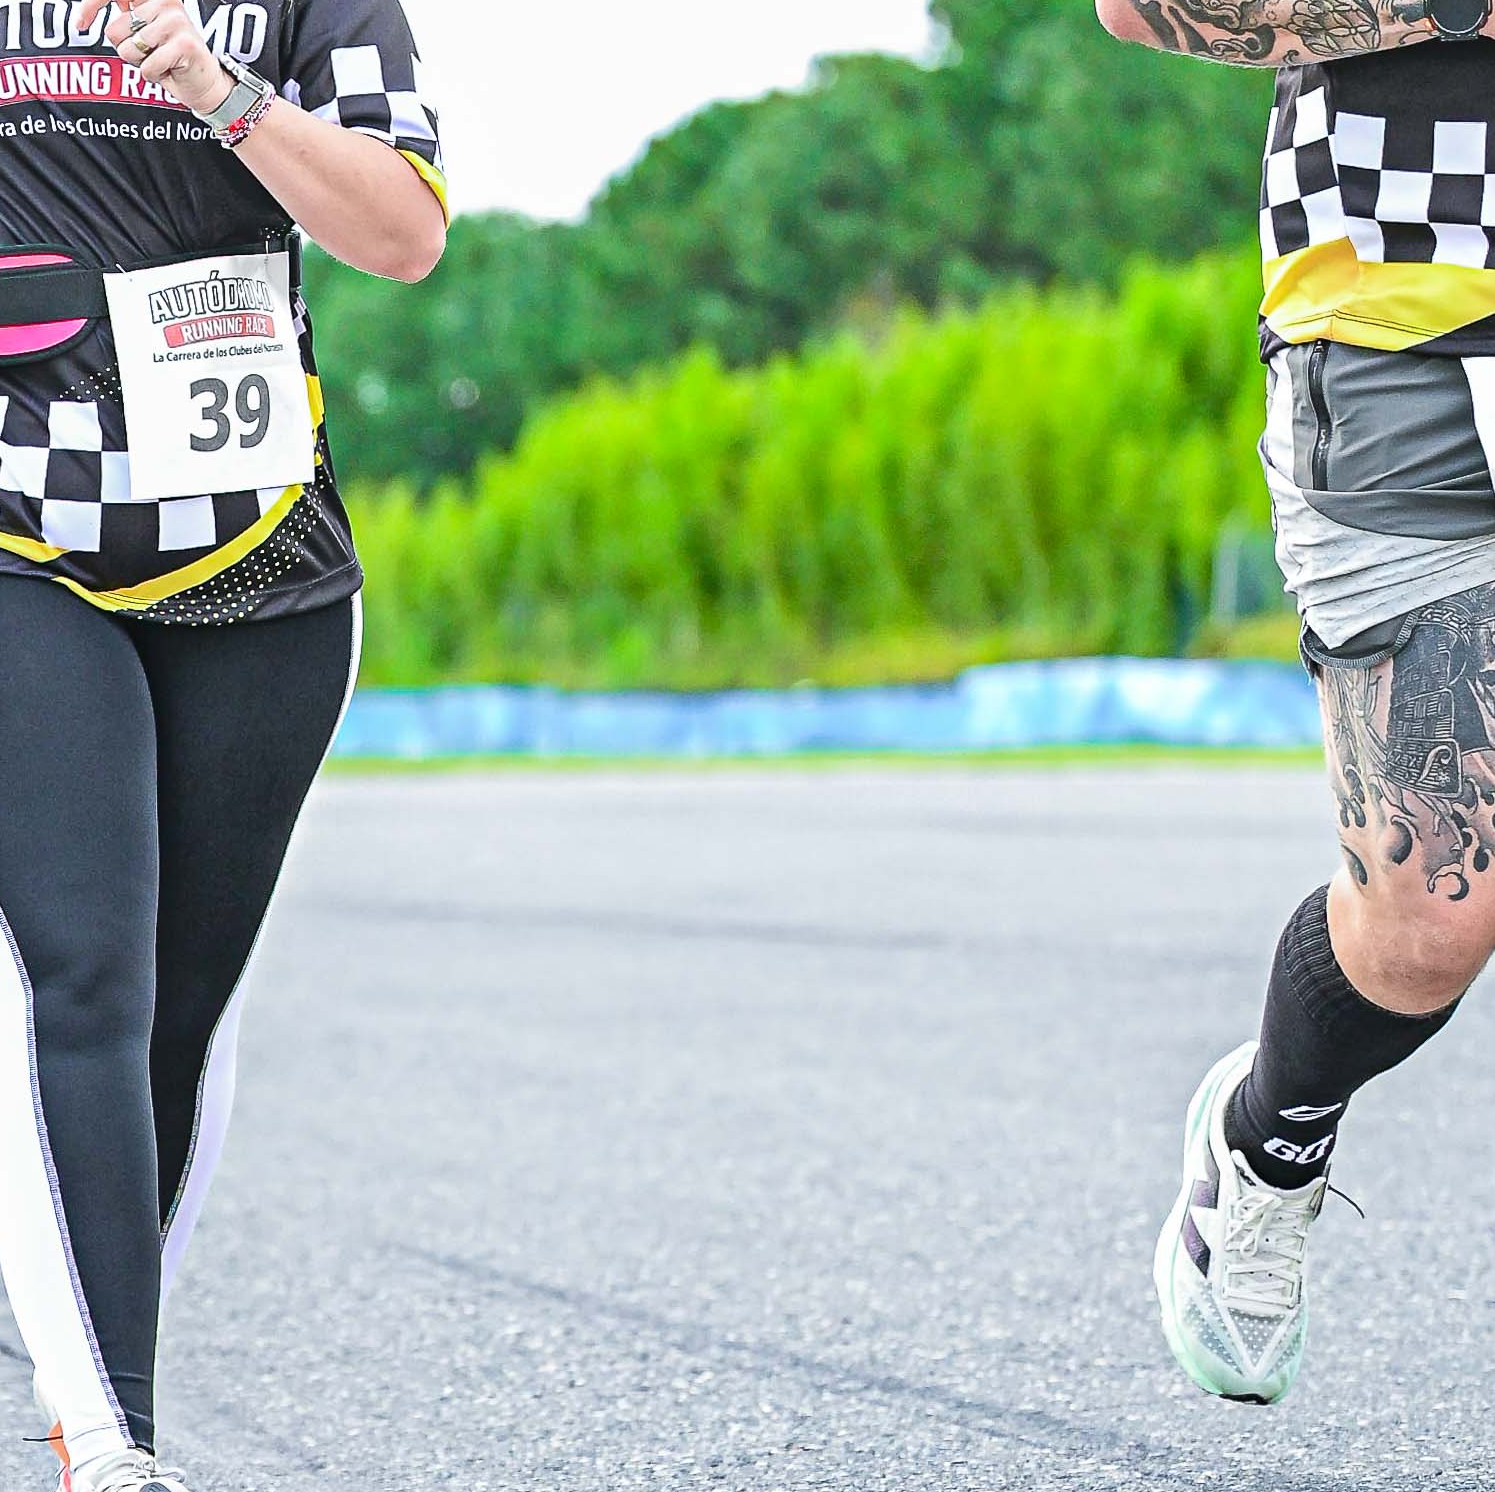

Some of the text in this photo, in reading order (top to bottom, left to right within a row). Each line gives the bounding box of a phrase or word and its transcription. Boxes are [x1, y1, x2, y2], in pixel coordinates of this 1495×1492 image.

[20, 114, 47, 135] de
[49, 113, 76, 134] los
[76, 117, 139, 139] Clubes
[142, 120, 171, 140] del
[176, 122, 218, 141] Nor
[148, 270, 275, 324] AUTÓDROMO
[181, 316, 268, 344] RUNNING RACE
[153, 353, 165, 363] La
[166, 350, 202, 362] Carrera
[204, 347, 215, 359] de
[216, 347, 228, 358] los
[229, 344, 253, 356] Clubes
[190, 374, 271, 452] 39
